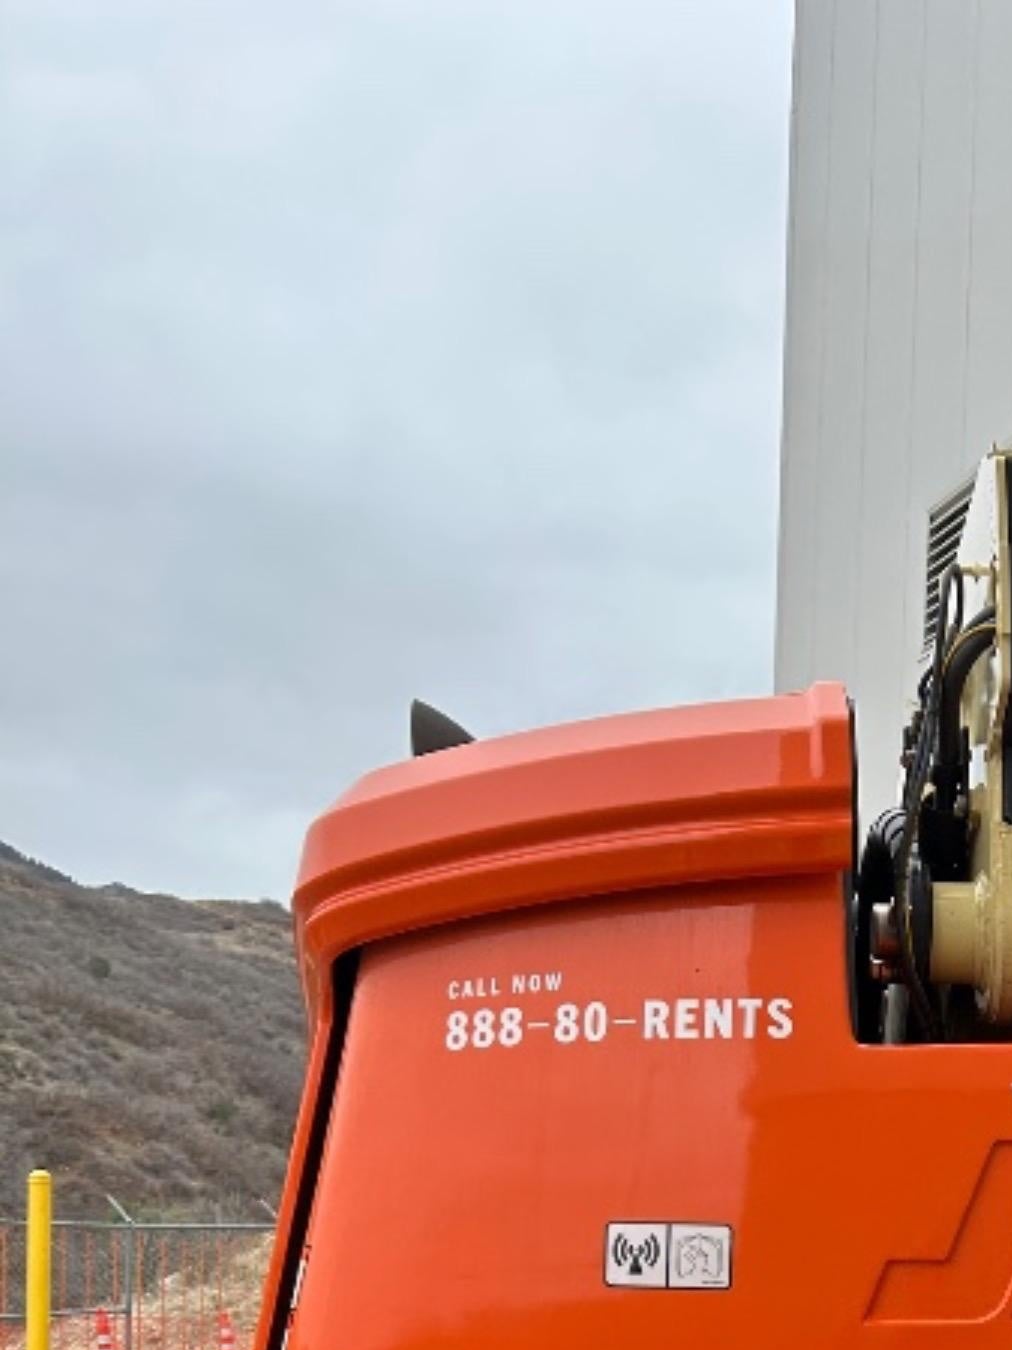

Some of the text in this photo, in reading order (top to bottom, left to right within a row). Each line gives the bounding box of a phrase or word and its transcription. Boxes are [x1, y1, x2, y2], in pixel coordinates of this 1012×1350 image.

[448, 971, 563, 1000] CALL NOW
[445, 998, 794, 1051] 888-80-RENTS
